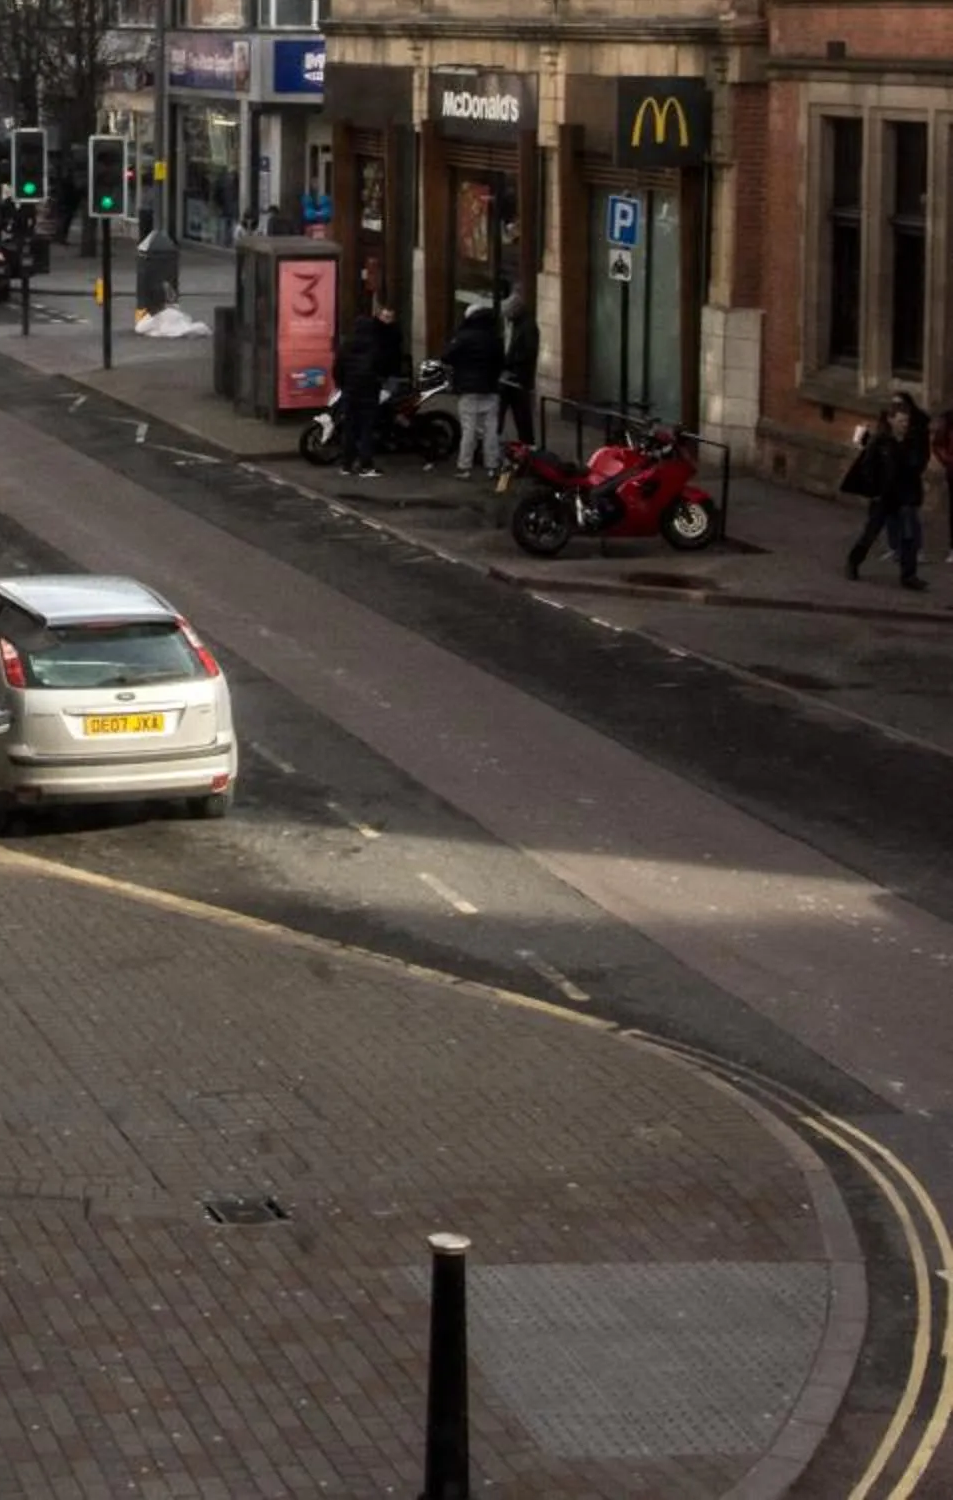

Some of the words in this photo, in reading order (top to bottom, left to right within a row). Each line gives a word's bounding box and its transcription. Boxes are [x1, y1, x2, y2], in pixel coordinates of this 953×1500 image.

[442, 91, 519, 122] McDonald's
[614, 203, 634, 240] P
[292, 272, 322, 318] 3
